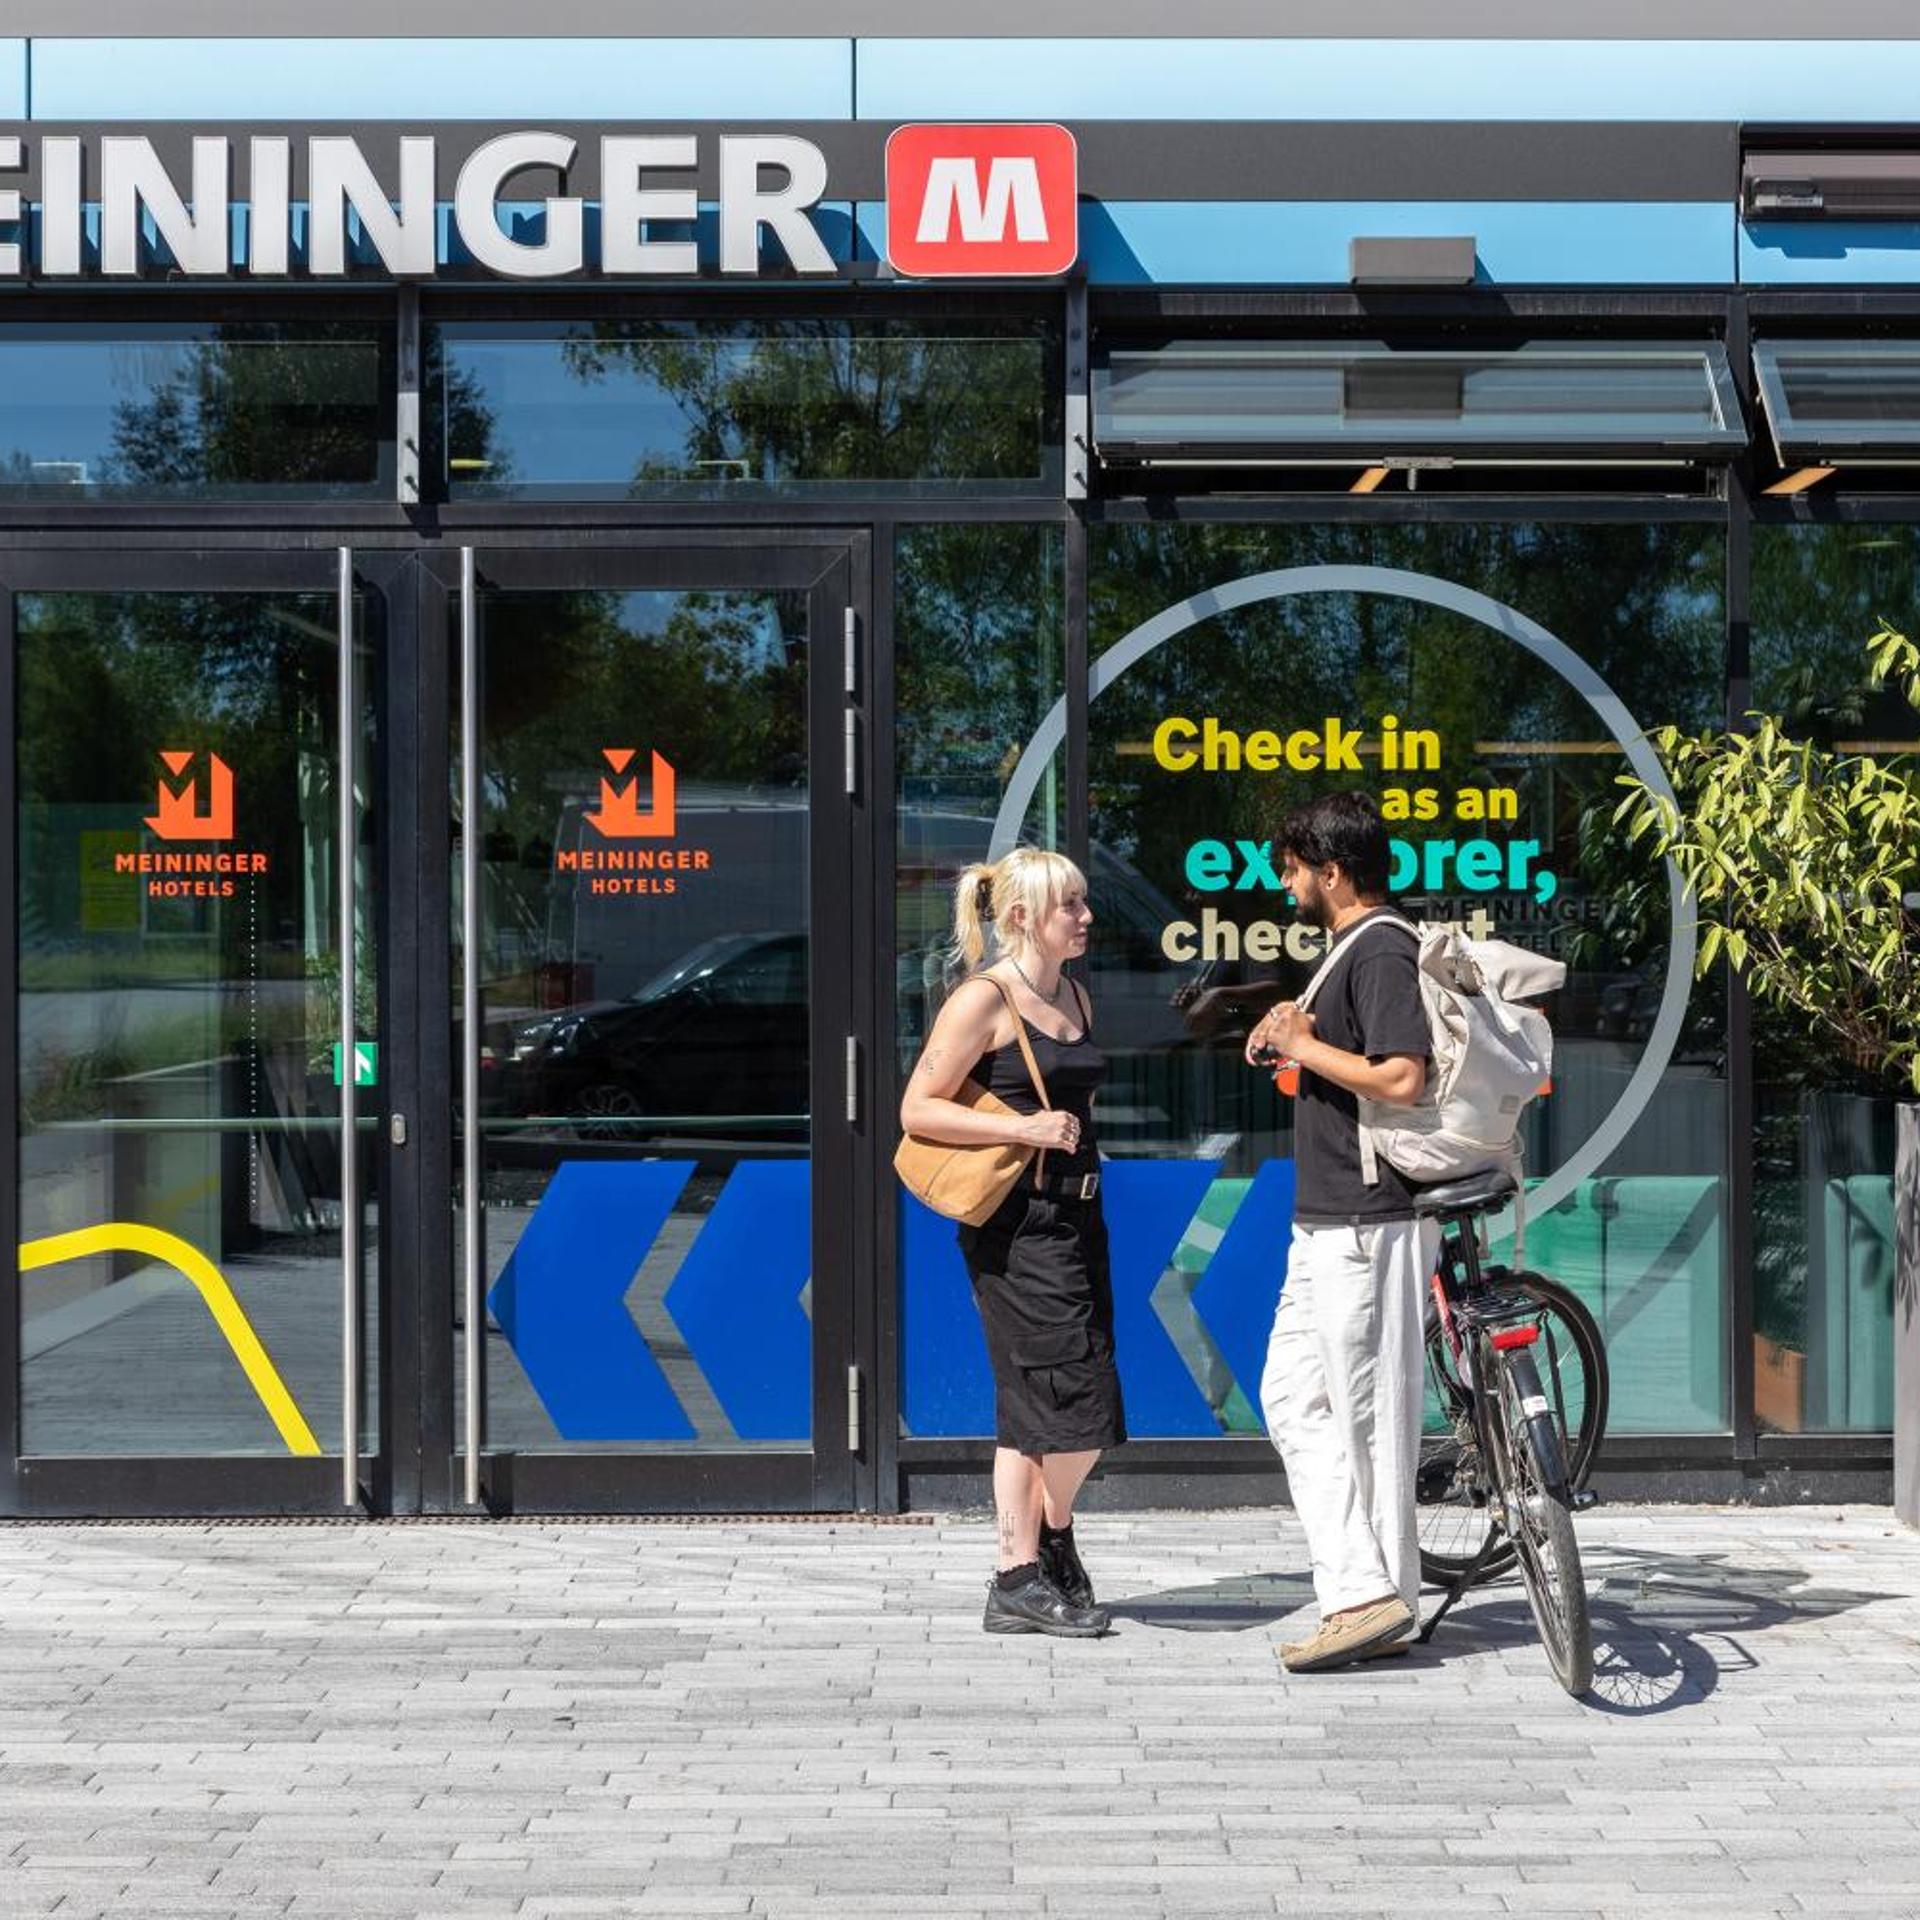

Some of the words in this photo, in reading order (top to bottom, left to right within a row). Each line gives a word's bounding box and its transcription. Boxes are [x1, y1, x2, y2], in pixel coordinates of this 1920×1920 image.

[0, 131, 838, 277] ININGER
[915, 156, 1049, 243] M
[1152, 717, 1364, 771] Check
[1380, 714, 1441, 770] in
[1381, 787, 1438, 820] as
[1456, 787, 1518, 820] an
[115, 853, 268, 873] MEININGER
[558, 850, 710, 870] MEININGER
[1185, 838, 1557, 905] exorer,
[149, 880, 234, 896] HOTELS
[592, 878, 676, 893] HOTELS
[1161, 907, 1334, 962] chec
